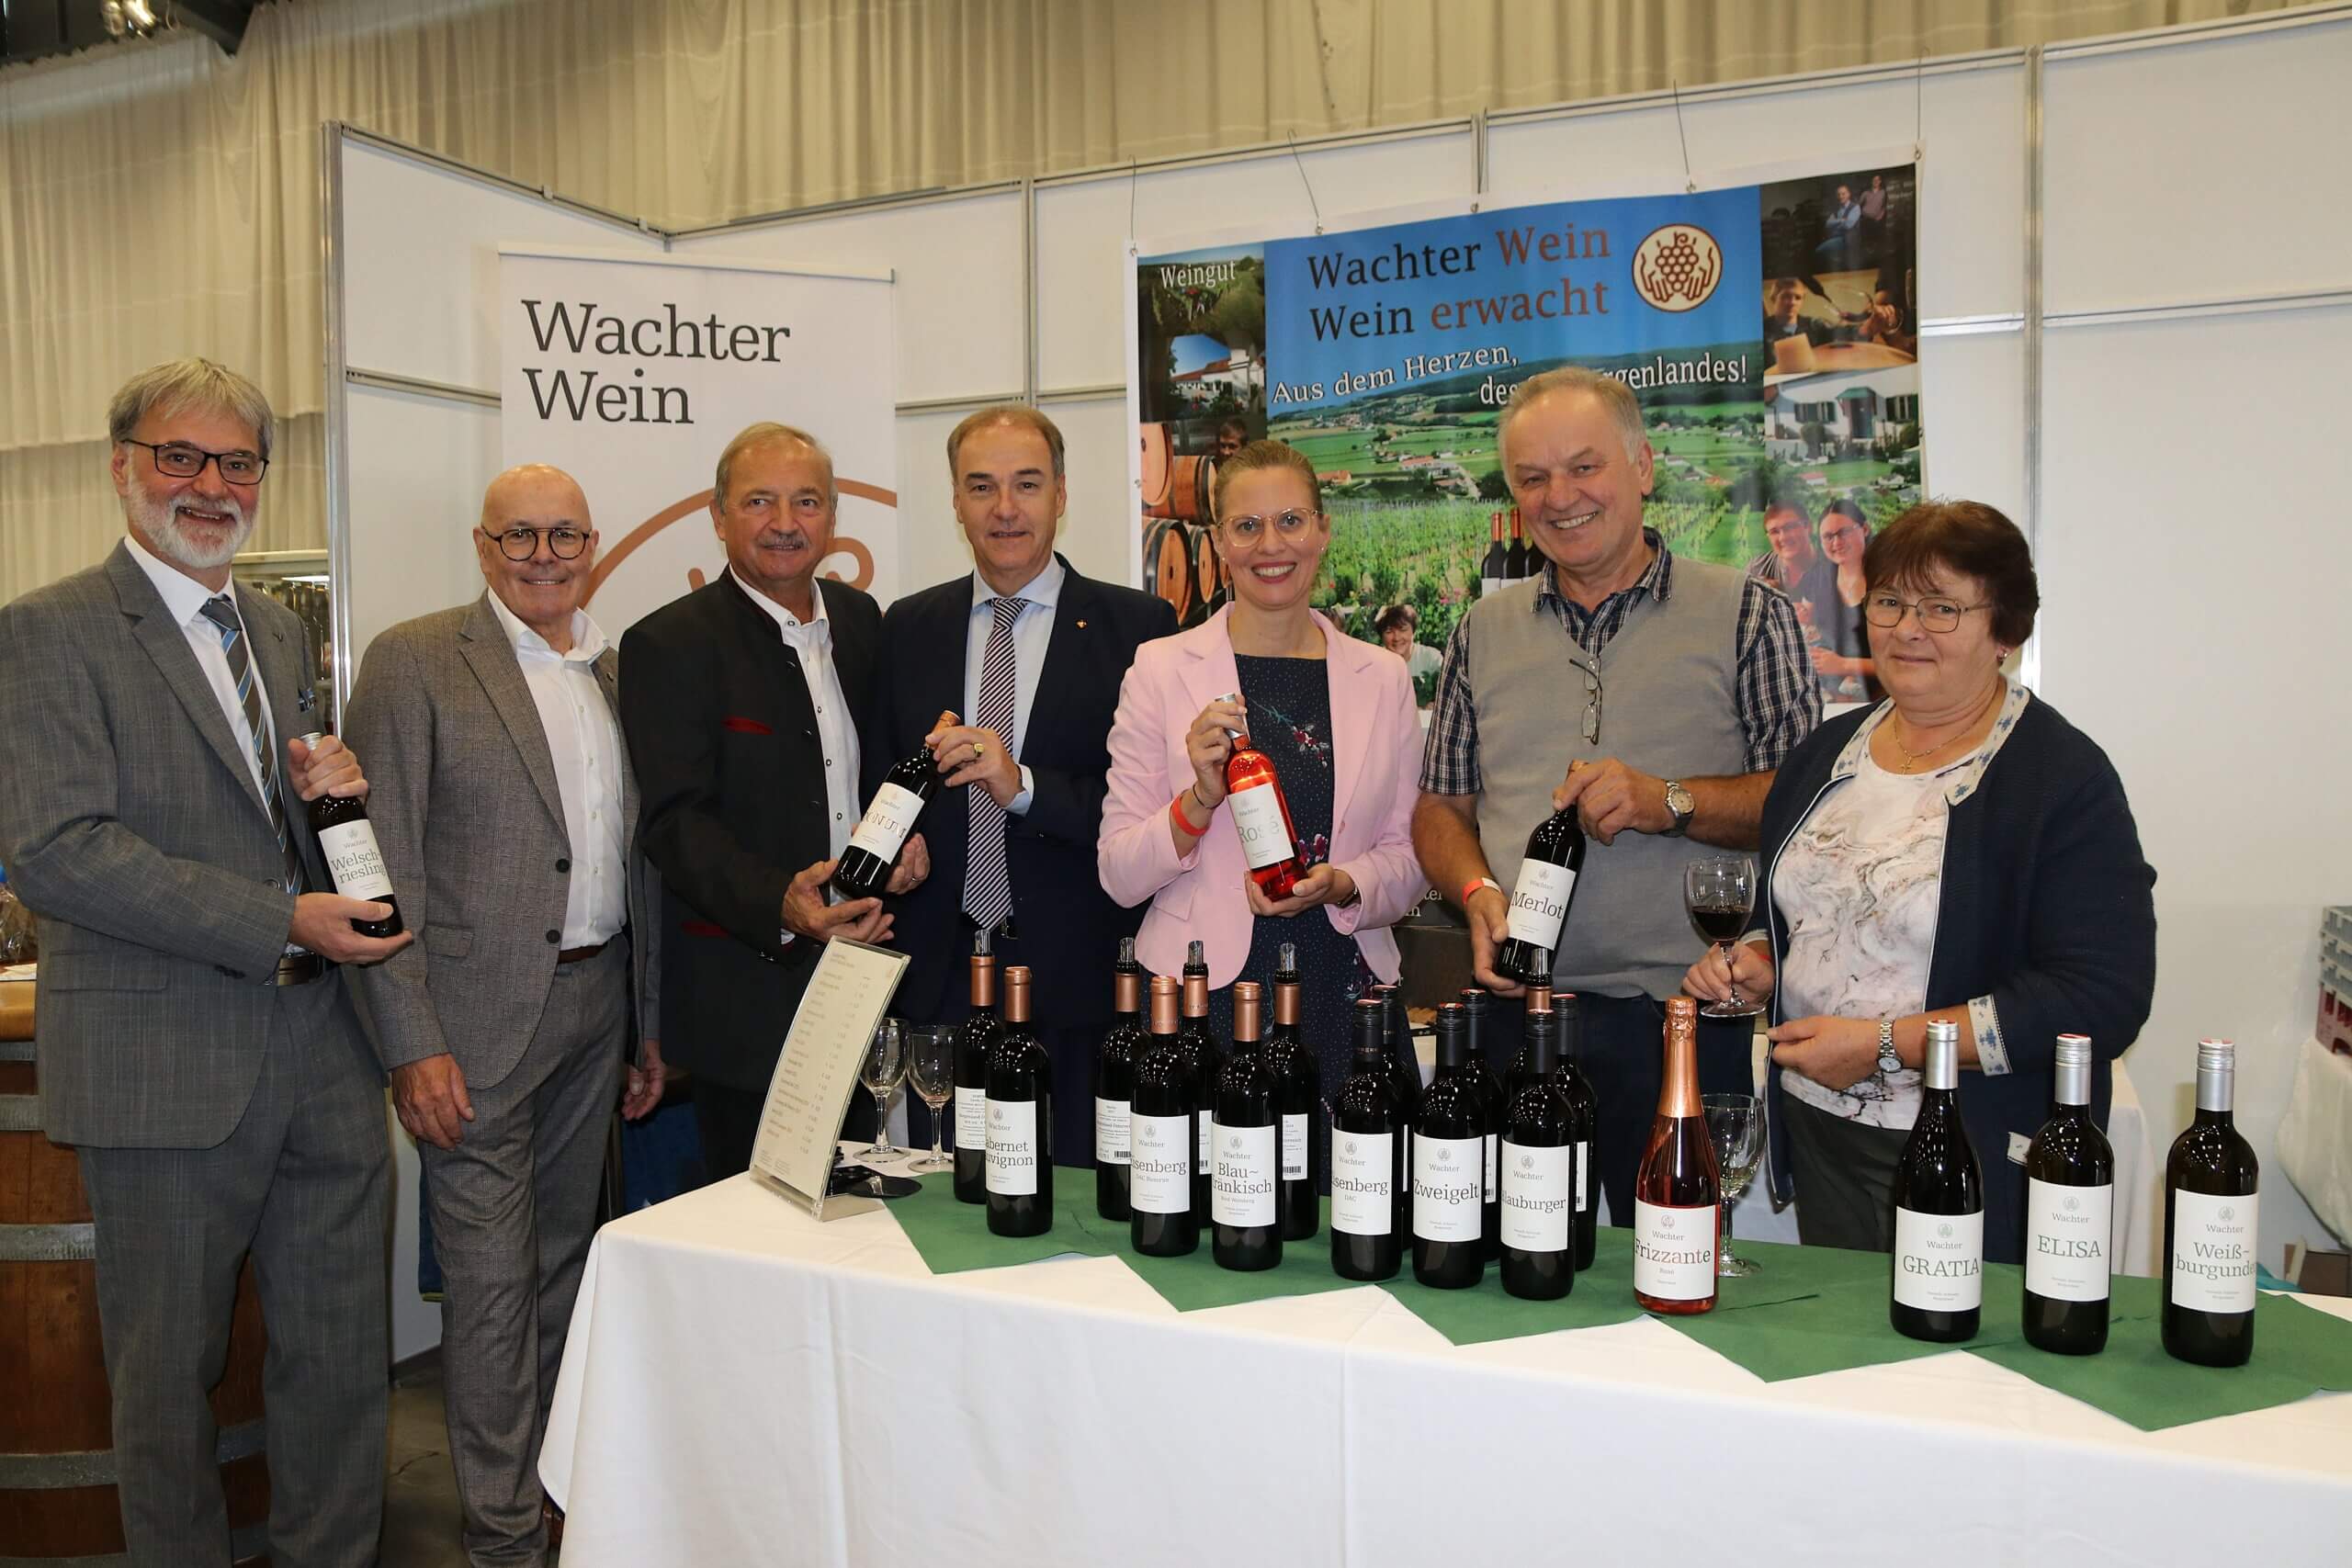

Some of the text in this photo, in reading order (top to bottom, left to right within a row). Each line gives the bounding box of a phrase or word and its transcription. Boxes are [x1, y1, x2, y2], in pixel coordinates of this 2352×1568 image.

[1307, 223, 1611, 290] Wachter Wein
[1160, 260, 1236, 288] Weingut
[1309, 278, 1610, 342] Wein erwacht
[521, 299, 791, 363] Wachter
[1272, 346, 1519, 404] Aus dem Herzen,
[522, 367, 695, 424] Wein
[331, 849, 381, 871] Welsch-
[339, 863, 386, 884] riesling
[1511, 891, 1564, 919] Merlot
[985, 1136, 1029, 1152] abernet
[1429, 1163, 1460, 1172] Wachter
[1513, 1170, 1544, 1180] Wachter
[1414, 1179, 1478, 1205] Zweigelt
[2052, 1213, 2091, 1224] Wachter
[2205, 1224, 2245, 1234] Wachter
[1652, 1230, 1685, 1240] Wachter
[1927, 1240, 1963, 1250] Wachter
[2037, 1235, 2102, 1258] ELISA
[1635, 1238, 1711, 1264] Frizzante
[2193, 1242, 2250, 1259] Weiß-
[1903, 1255, 1980, 1278] GRATIA
